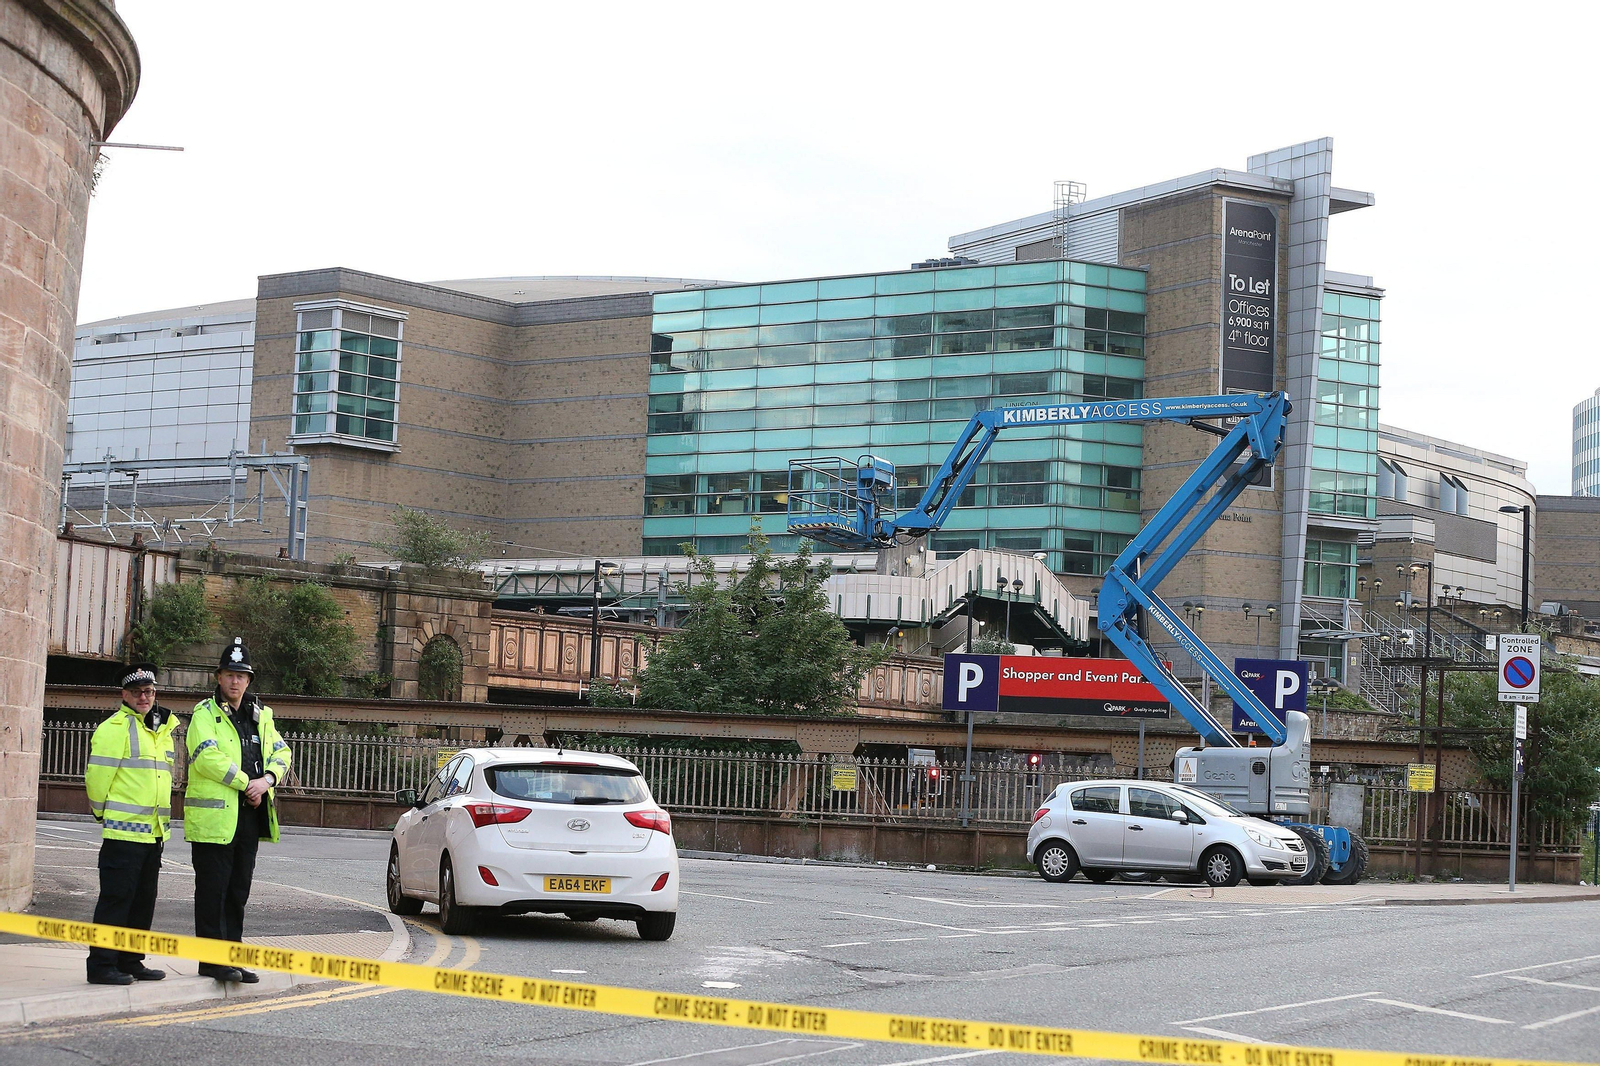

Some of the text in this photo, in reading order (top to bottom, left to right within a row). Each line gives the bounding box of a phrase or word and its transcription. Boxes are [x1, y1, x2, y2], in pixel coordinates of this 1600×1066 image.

[1230, 226, 1271, 241] ArenaPoint
[1229, 274, 1270, 294] To Let
[1229, 299, 1270, 317] Offices
[1228, 316, 1269, 331] 6,900 sq ft
[1228, 330, 1269, 346] 4th floor
[958, 662, 984, 702] P
[1002, 667, 1151, 684] Shopper and Event Par
[1275, 670, 1300, 708] P
[1204, 770, 1236, 781] Genie
[550, 879, 606, 892] EA64 EKF
[37, 920, 66, 939] CRIME
[70, 925, 98, 944] SCENE
[114, 931, 125, 947] DO
[130, 933, 146, 950] NOT
[150, 936, 179, 955] ENTER
[229, 946, 260, 965] CRIME
[263, 950, 294, 970] SCENE
[311, 956, 324, 974] DO
[327, 959, 346, 977] NOT
[350, 961, 380, 981] ENTER
[434, 972, 468, 992] CRIME
[471, 976, 504, 996] SCENE
[522, 982, 536, 1000] DO
[540, 984, 560, 1002] NOT
[564, 987, 597, 1007] ENTER
[654, 996, 690, 1016] CRIME
[693, 1000, 728, 1020] SCENE
[748, 1006, 763, 1025] DO
[766, 1008, 788, 1027] NOT
[792, 1010, 827, 1031] ENTER
[889, 1019, 927, 1040] CRIME
[930, 1022, 967, 1044] SCENE
[988, 1027, 1004, 1047] DO
[1008, 1030, 1032, 1049] NOT
[1036, 1032, 1073, 1052] ENTER
[1138, 1040, 1178, 1060] CRIME
[1183, 1043, 1222, 1063] SCENE
[1245, 1048, 1262, 1066] DO
[1266, 1050, 1291, 1066] NOT
